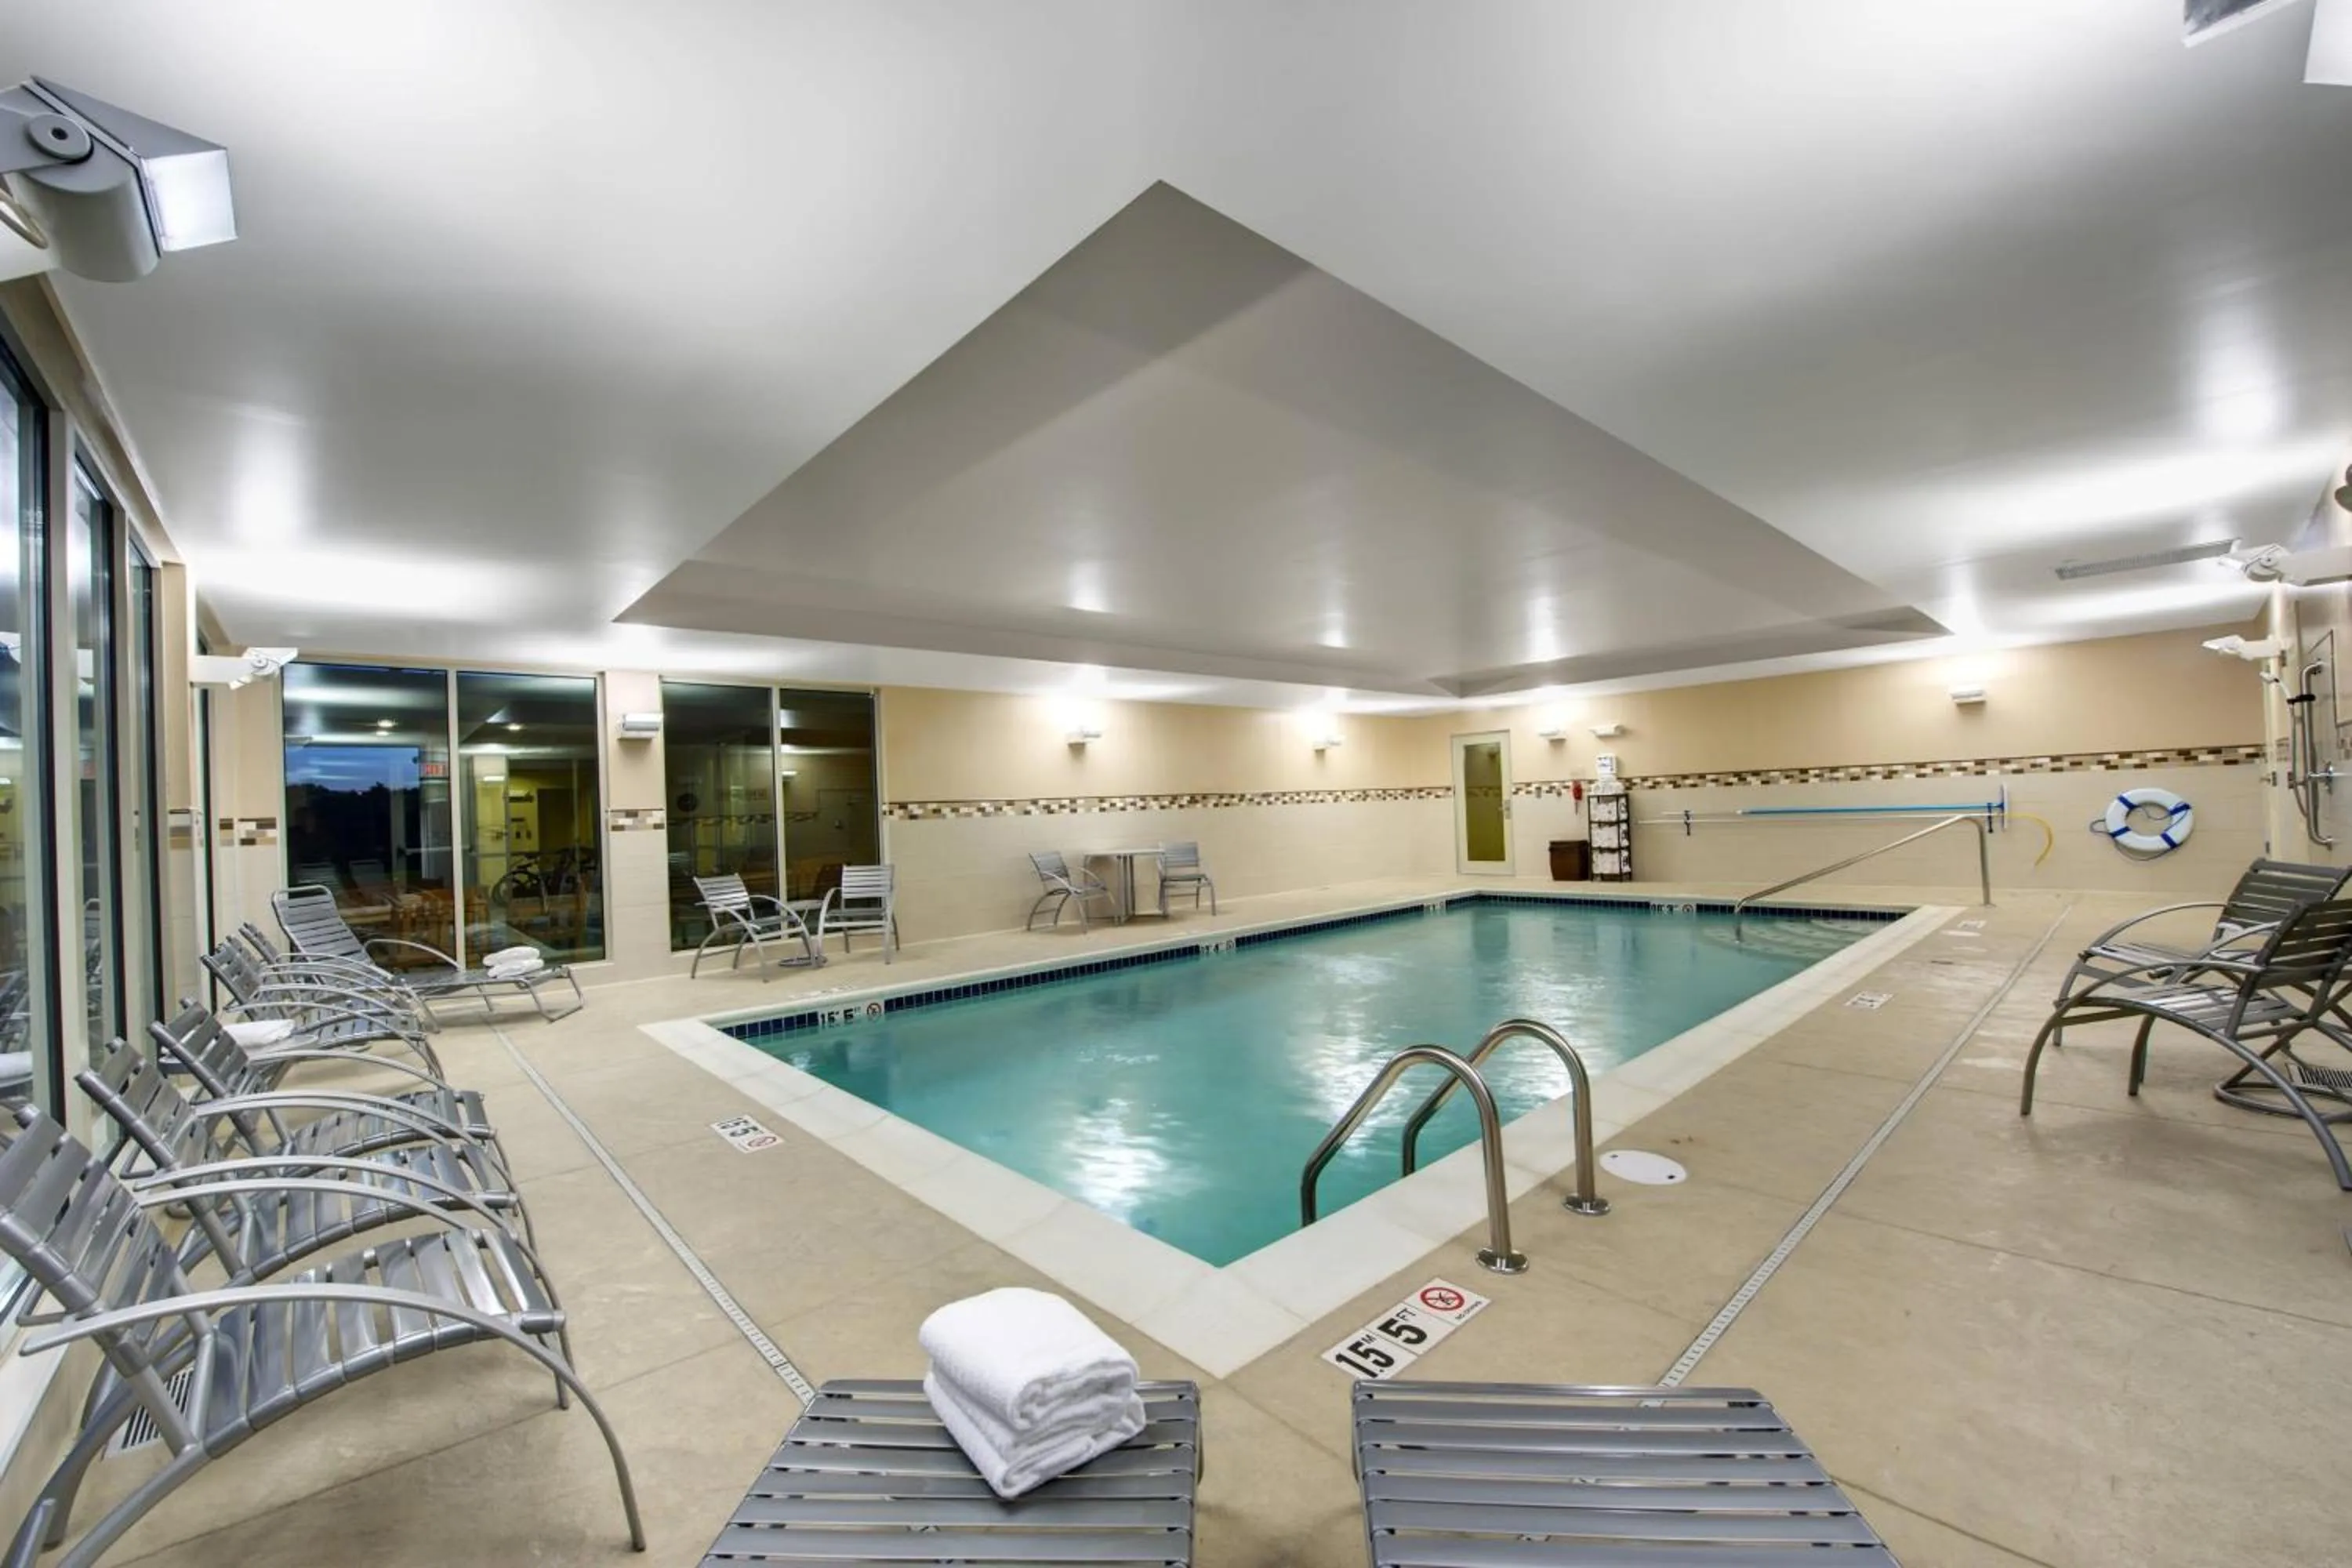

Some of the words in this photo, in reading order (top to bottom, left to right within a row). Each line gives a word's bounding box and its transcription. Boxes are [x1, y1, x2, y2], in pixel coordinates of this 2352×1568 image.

[1396, 1308, 1416, 1321] FT
[1361, 1334, 1377, 1345] M
[1377, 1318, 1427, 1345] 5
[1335, 1341, 1395, 1378] 1.5
